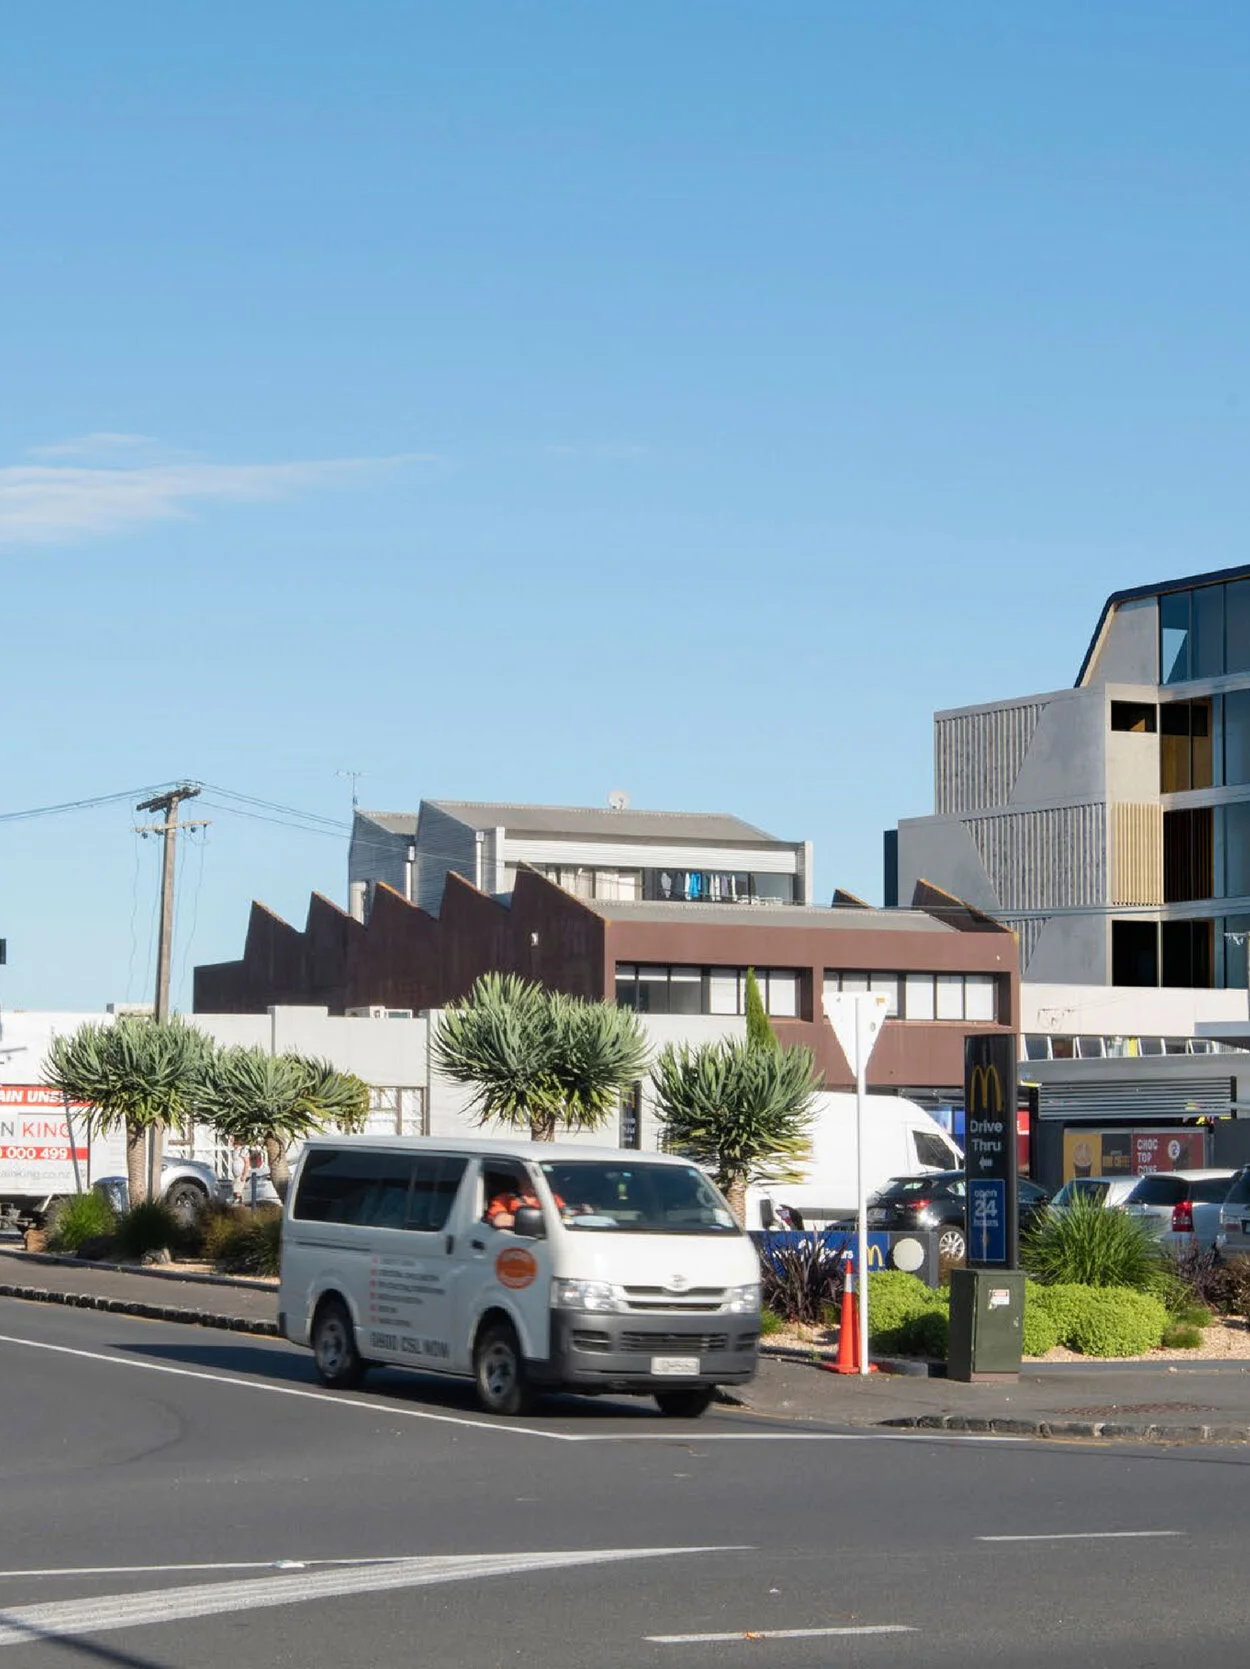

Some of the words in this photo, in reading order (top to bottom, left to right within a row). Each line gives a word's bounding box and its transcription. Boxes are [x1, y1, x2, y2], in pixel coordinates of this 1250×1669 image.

[969, 1120, 1004, 1134] Drive
[971, 1138, 1002, 1152] Thru
[1137, 1139, 1158, 1151] CHOC
[40, 1147, 68, 1159] 499
[1137, 1152, 1152, 1163] TOP
[974, 1200, 998, 1217] 24
